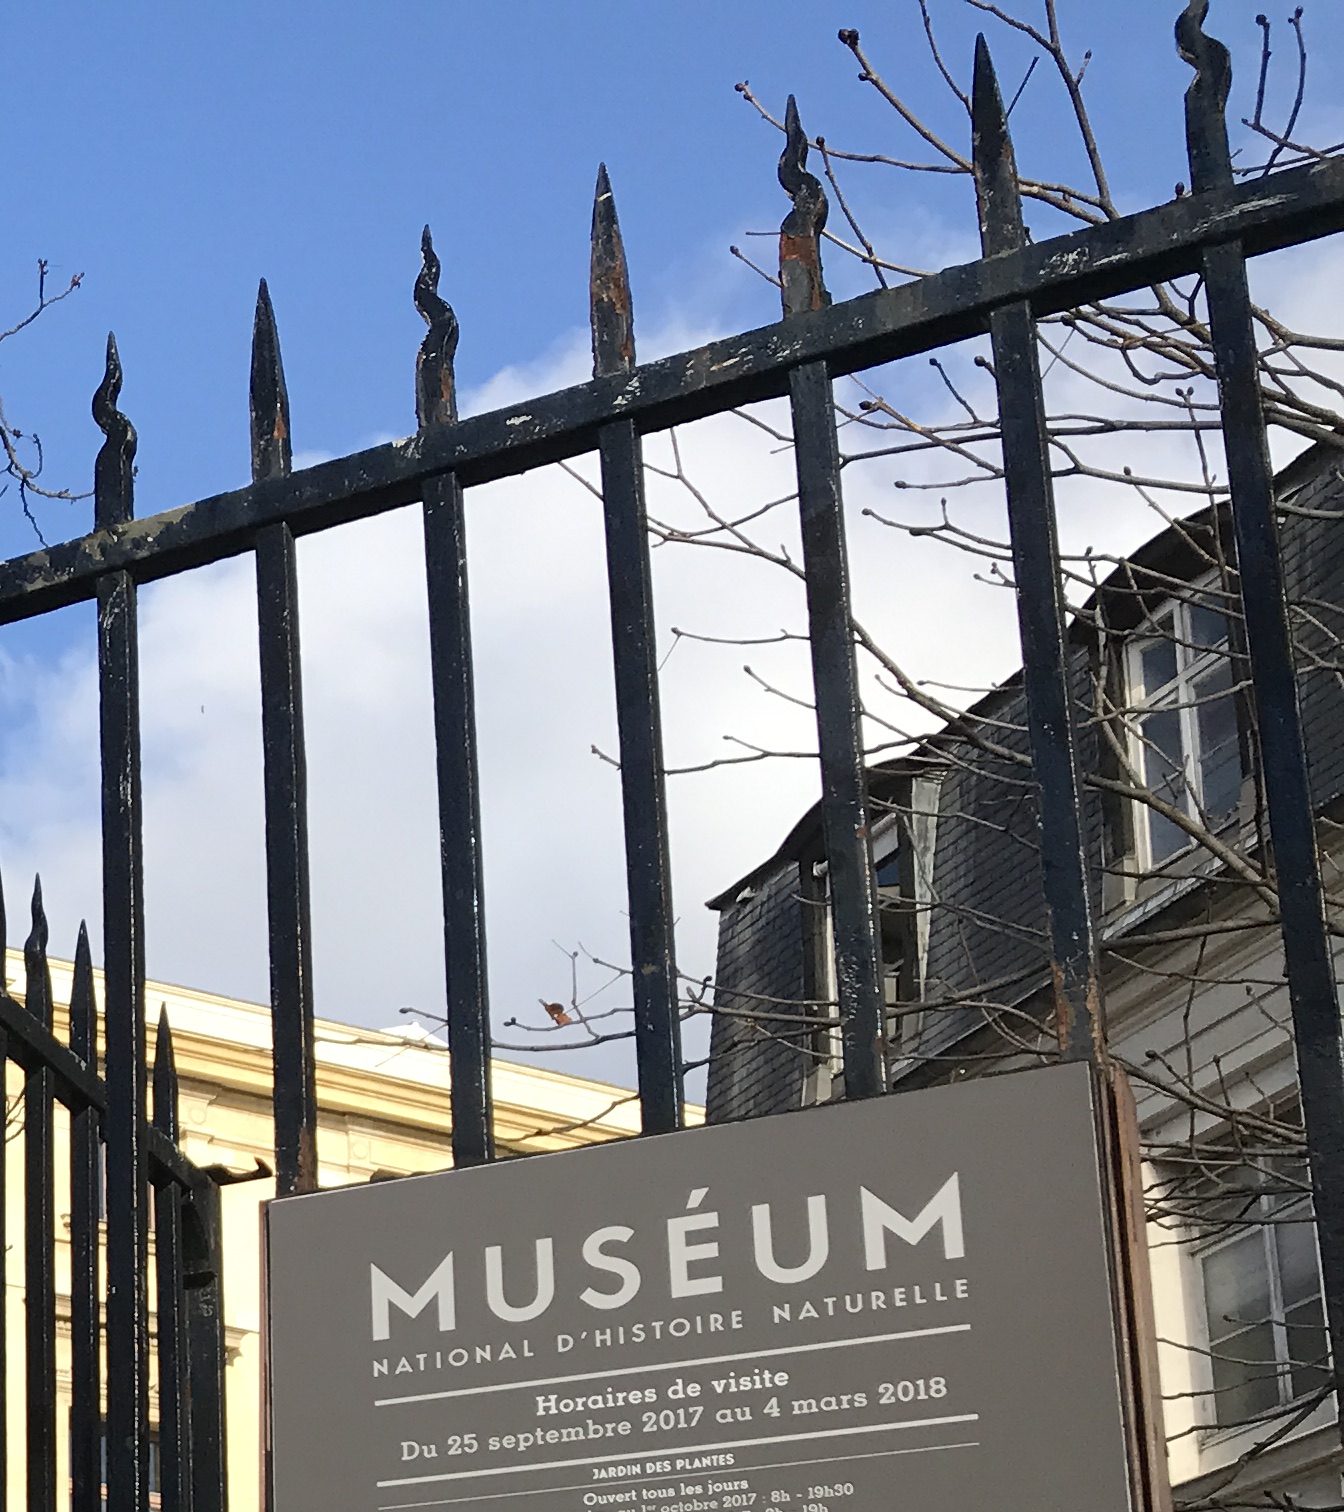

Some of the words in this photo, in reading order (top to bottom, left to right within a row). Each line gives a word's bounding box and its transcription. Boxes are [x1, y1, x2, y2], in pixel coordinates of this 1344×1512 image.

[370, 1171, 965, 1342] MUSÉUM
[372, 1339, 534, 1378] NATIONAL
[556, 1309, 744, 1353] D'HISTOIRE
[772, 1278, 969, 1324] NATURELLE
[400, 1440, 439, 1461] Du
[447, 1433, 479, 1456] 25
[488, 1419, 632, 1452] septembre
[641, 1405, 704, 1433] 2017
[715, 1406, 753, 1424] au
[762, 1396, 781, 1418] 4
[791, 1392, 868, 1415] mars
[877, 1376, 948, 1405] 2018
[535, 1386, 657, 1417] Horaires
[666, 1378, 702, 1400] de
[710, 1368, 790, 1394] visite
[582, 1489, 638, 1506] Ouvert
[641, 1487, 676, 1500] tous
[679, 1482, 704, 1496] les
[707, 1479, 749, 1496] jours
[592, 1463, 642, 1480] JARDIN
[645, 1460, 672, 1474] DES
[675, 1453, 735, 1471] PLANTES
